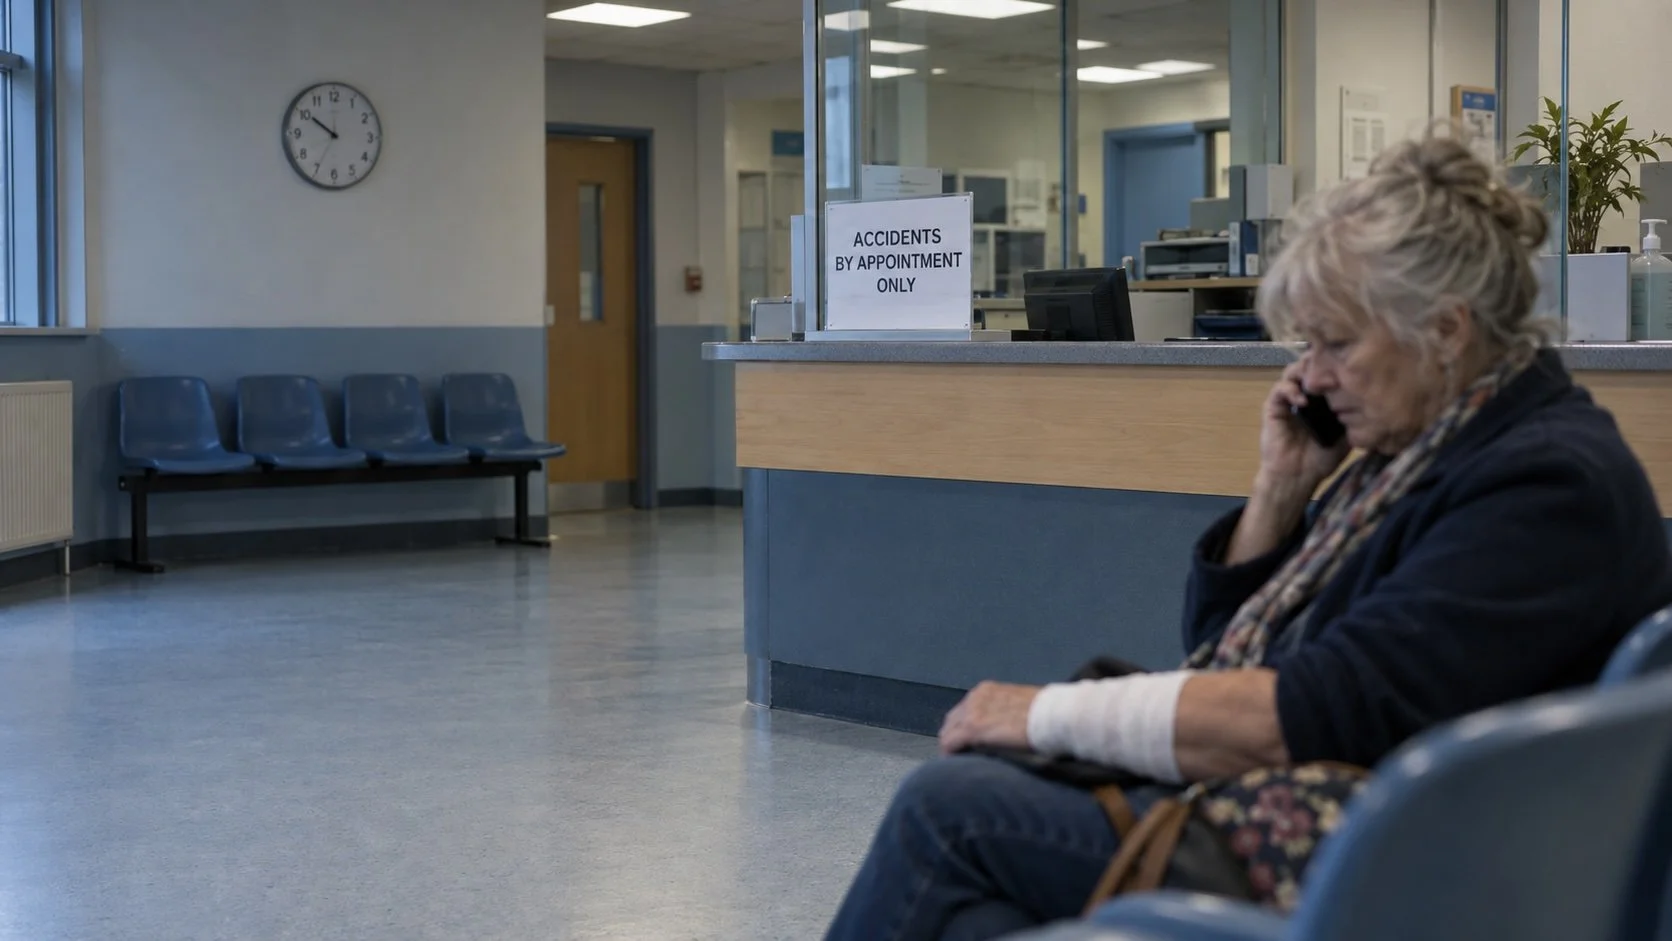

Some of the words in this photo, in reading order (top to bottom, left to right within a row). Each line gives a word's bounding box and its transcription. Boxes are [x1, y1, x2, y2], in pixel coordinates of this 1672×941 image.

[312, 95, 322, 107] 11
[329, 91, 340, 103] 12
[300, 109, 311, 120] 10
[361, 112, 369, 124] 2
[294, 128, 301, 139] 9
[367, 131, 374, 144] 3
[300, 148, 307, 160] 8
[361, 151, 368, 162] 4
[314, 162, 320, 174] 7
[330, 168, 338, 180] 6
[348, 164, 356, 176] 5
[853, 228, 942, 247] ACCIDENTS
[835, 256, 854, 271] BY
[857, 252, 963, 270] APPOINTMENT
[876, 277, 916, 293] ONLY
